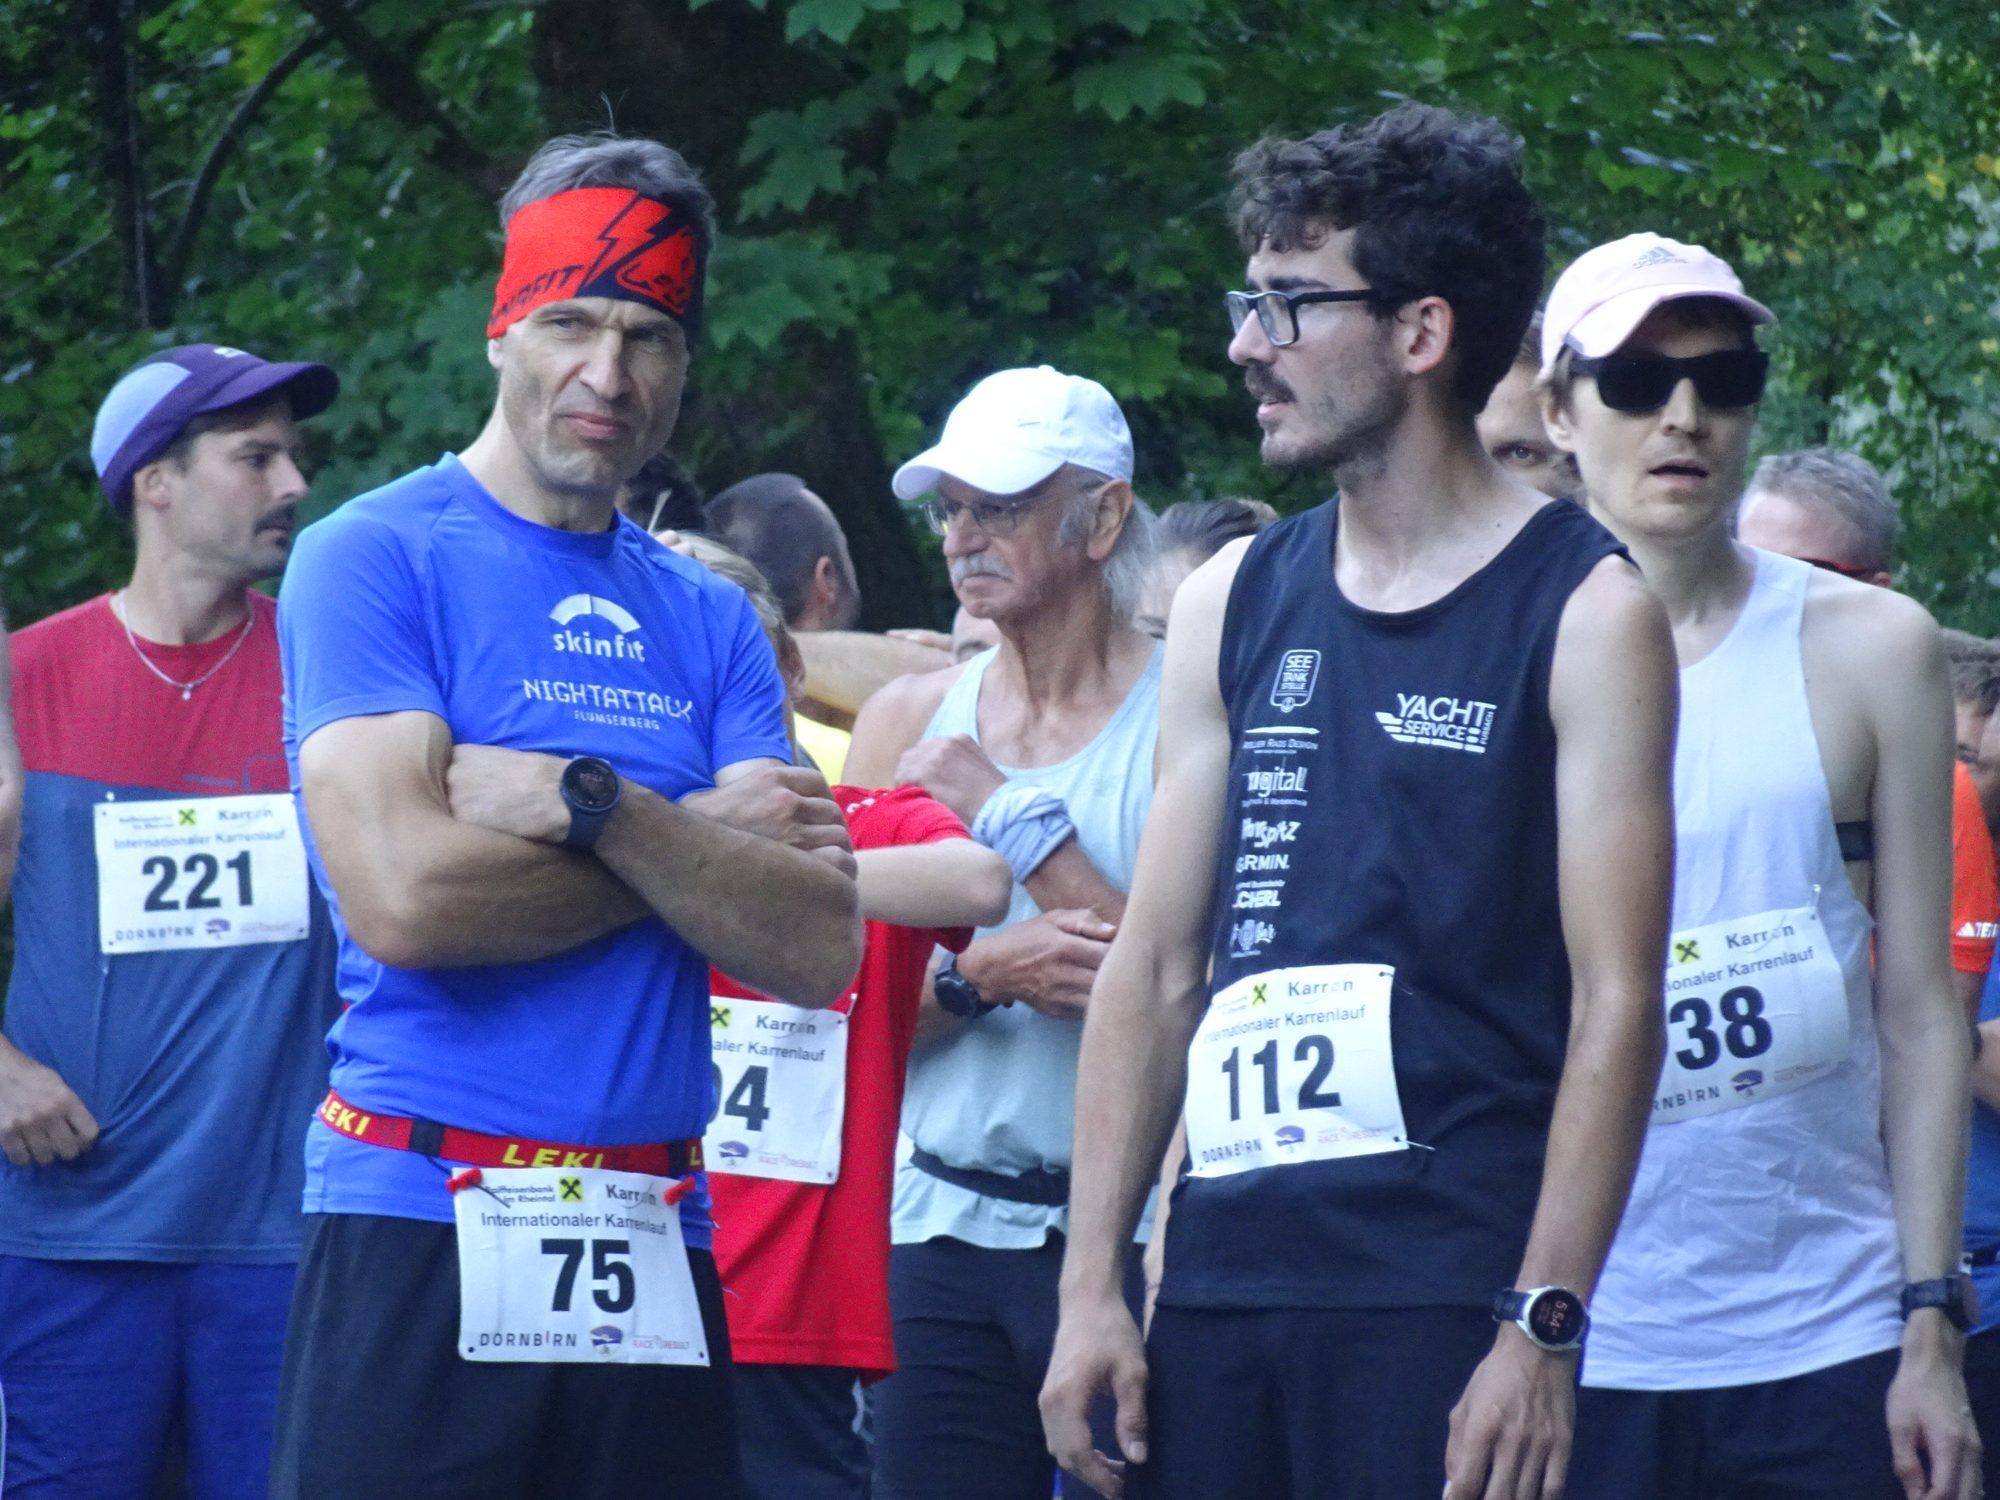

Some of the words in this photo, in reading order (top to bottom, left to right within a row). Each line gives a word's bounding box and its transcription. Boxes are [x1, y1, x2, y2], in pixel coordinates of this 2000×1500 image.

[553, 630, 646, 662] skinfit
[1286, 655, 1314, 669] SEE
[574, 710, 661, 730] FLUMSERBERG
[1397, 693, 1498, 727] YACHT
[1402, 720, 1467, 740] SERVICE
[114, 834, 210, 850] Internationaler
[215, 828, 286, 844] Karrenlauf
[142, 850, 254, 913] 221
[1727, 946, 1814, 978] Karrenlauf
[1285, 1005, 1366, 1028] Karrenlauf
[1669, 985, 1773, 1071] 38
[748, 1042, 826, 1062] Karrenlauf
[1221, 1034, 1342, 1122] 112
[502, 1144, 604, 1169] LEKI
[481, 1212, 600, 1228] Internationaler
[605, 1213, 668, 1236] Karrenlauf
[540, 1238, 636, 1314] 75
[480, 1331, 577, 1348] DORNBIRN
